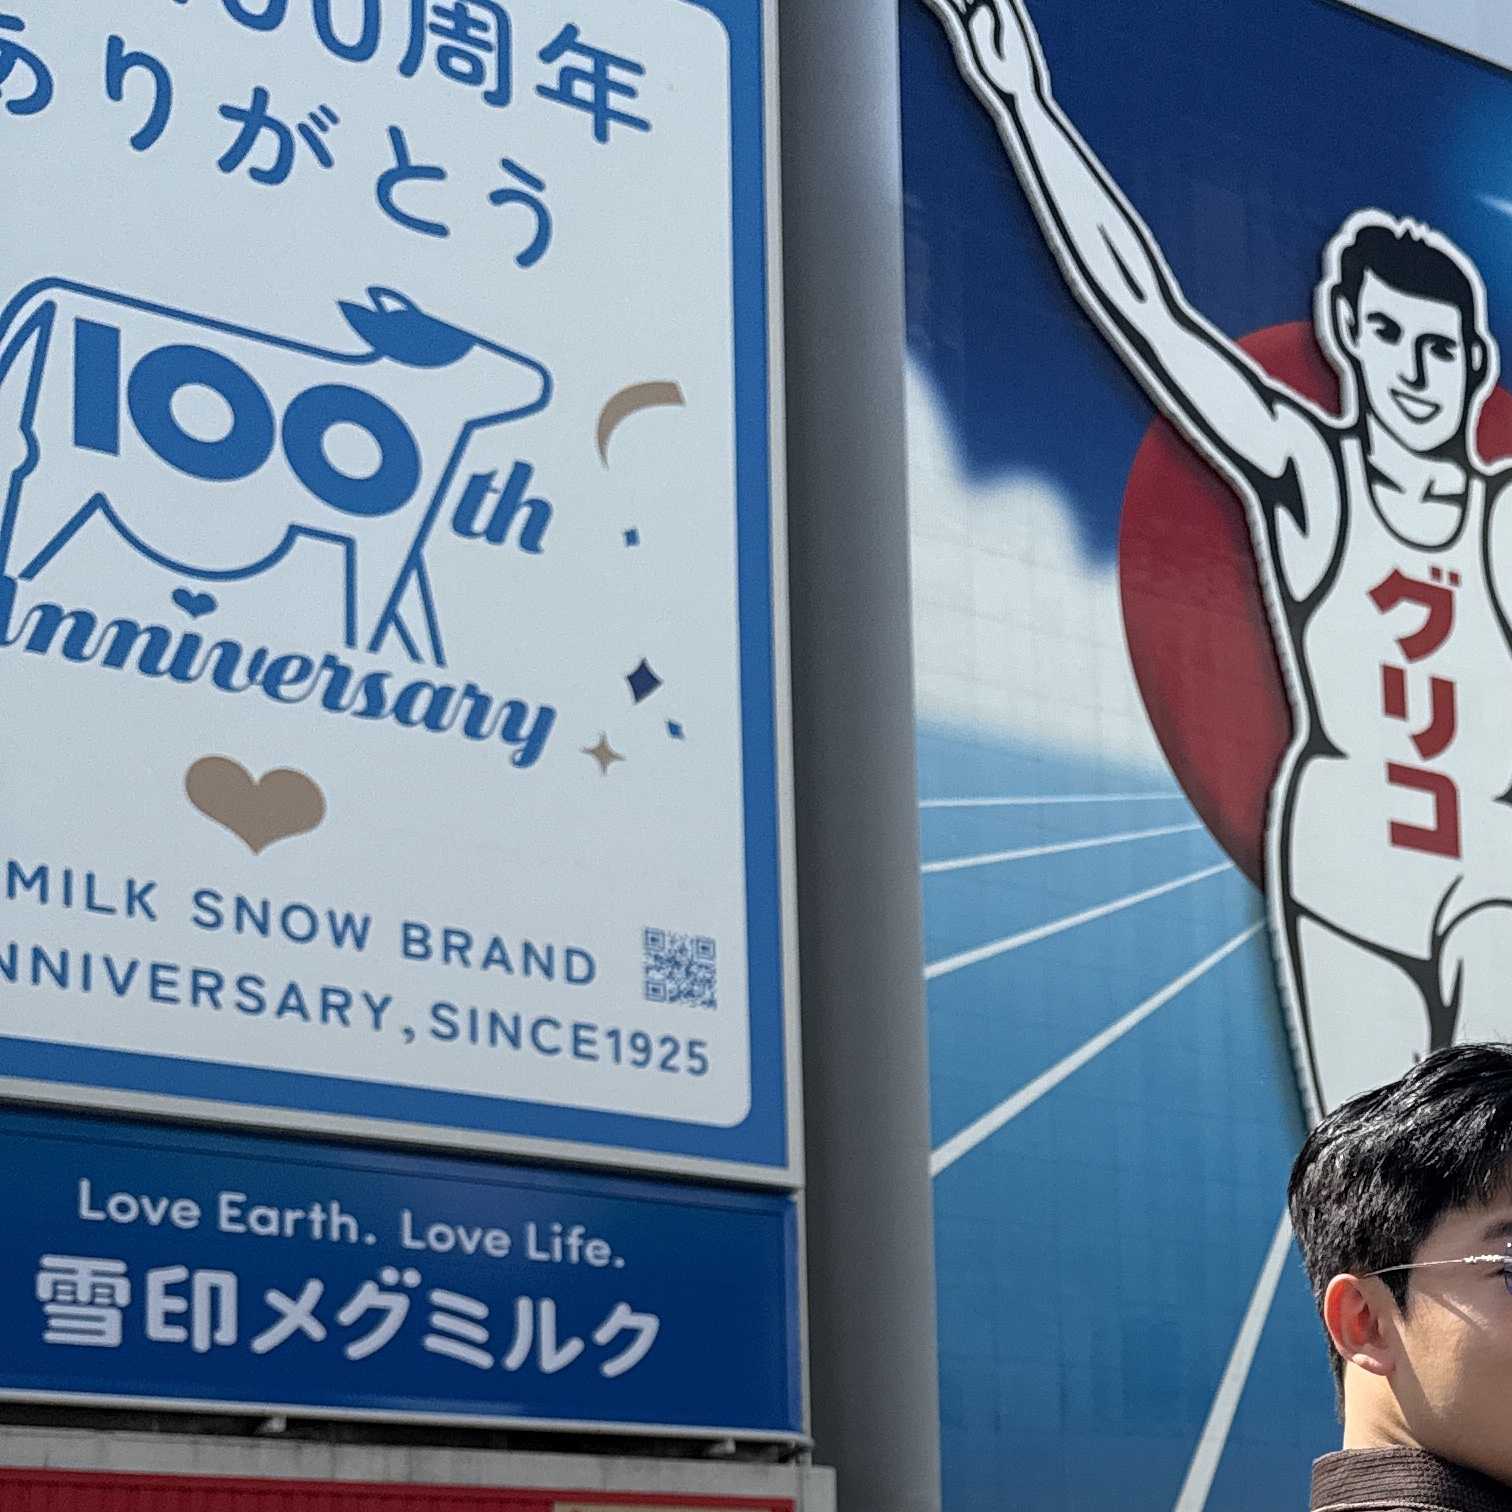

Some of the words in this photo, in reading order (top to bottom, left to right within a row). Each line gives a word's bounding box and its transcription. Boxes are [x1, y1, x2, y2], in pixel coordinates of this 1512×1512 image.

[0, 13, 553, 268] ありがとう
[172, 0, 652, 143] 0周年
[0, 574, 557, 768] nniversary
[1368, 565, 1462, 860] グリコ
[192, 889, 373, 953] SNOW
[401, 921, 597, 987] BRAND
[78, 1178, 200, 1230] Love
[218, 1193, 376, 1246] Earth.
[402, 1210, 511, 1258] Love
[527, 1223, 626, 1268] Life.
[36, 1253, 661, 1378] 雪印メグミルク
